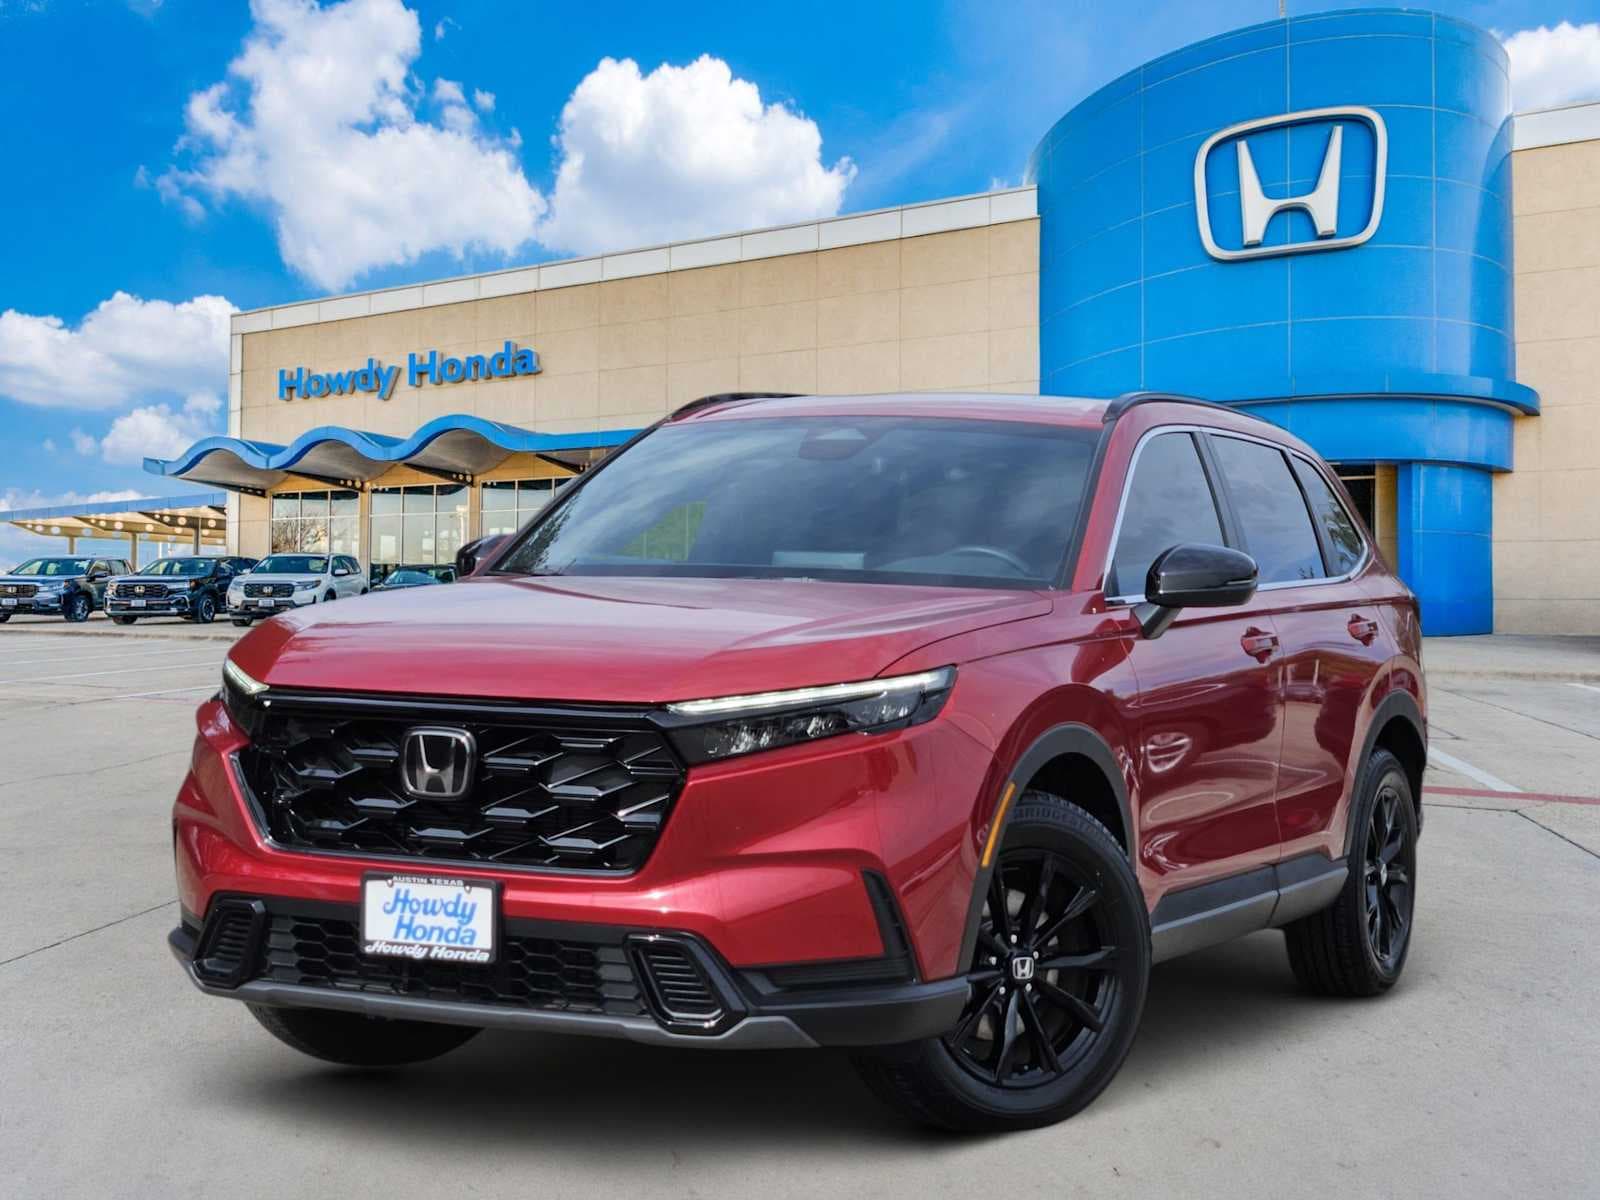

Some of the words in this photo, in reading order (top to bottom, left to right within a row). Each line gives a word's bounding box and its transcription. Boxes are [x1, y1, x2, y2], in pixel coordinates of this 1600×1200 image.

[278, 357, 401, 401] Howdy
[408, 340, 542, 388] Honda
[392, 875, 428, 884] AUSTIN
[430, 878, 465, 887] TEXAS
[382, 887, 478, 926] Howdy
[393, 914, 477, 946] Honda
[364, 940, 429, 959] Howdy
[429, 946, 490, 961] Honda
